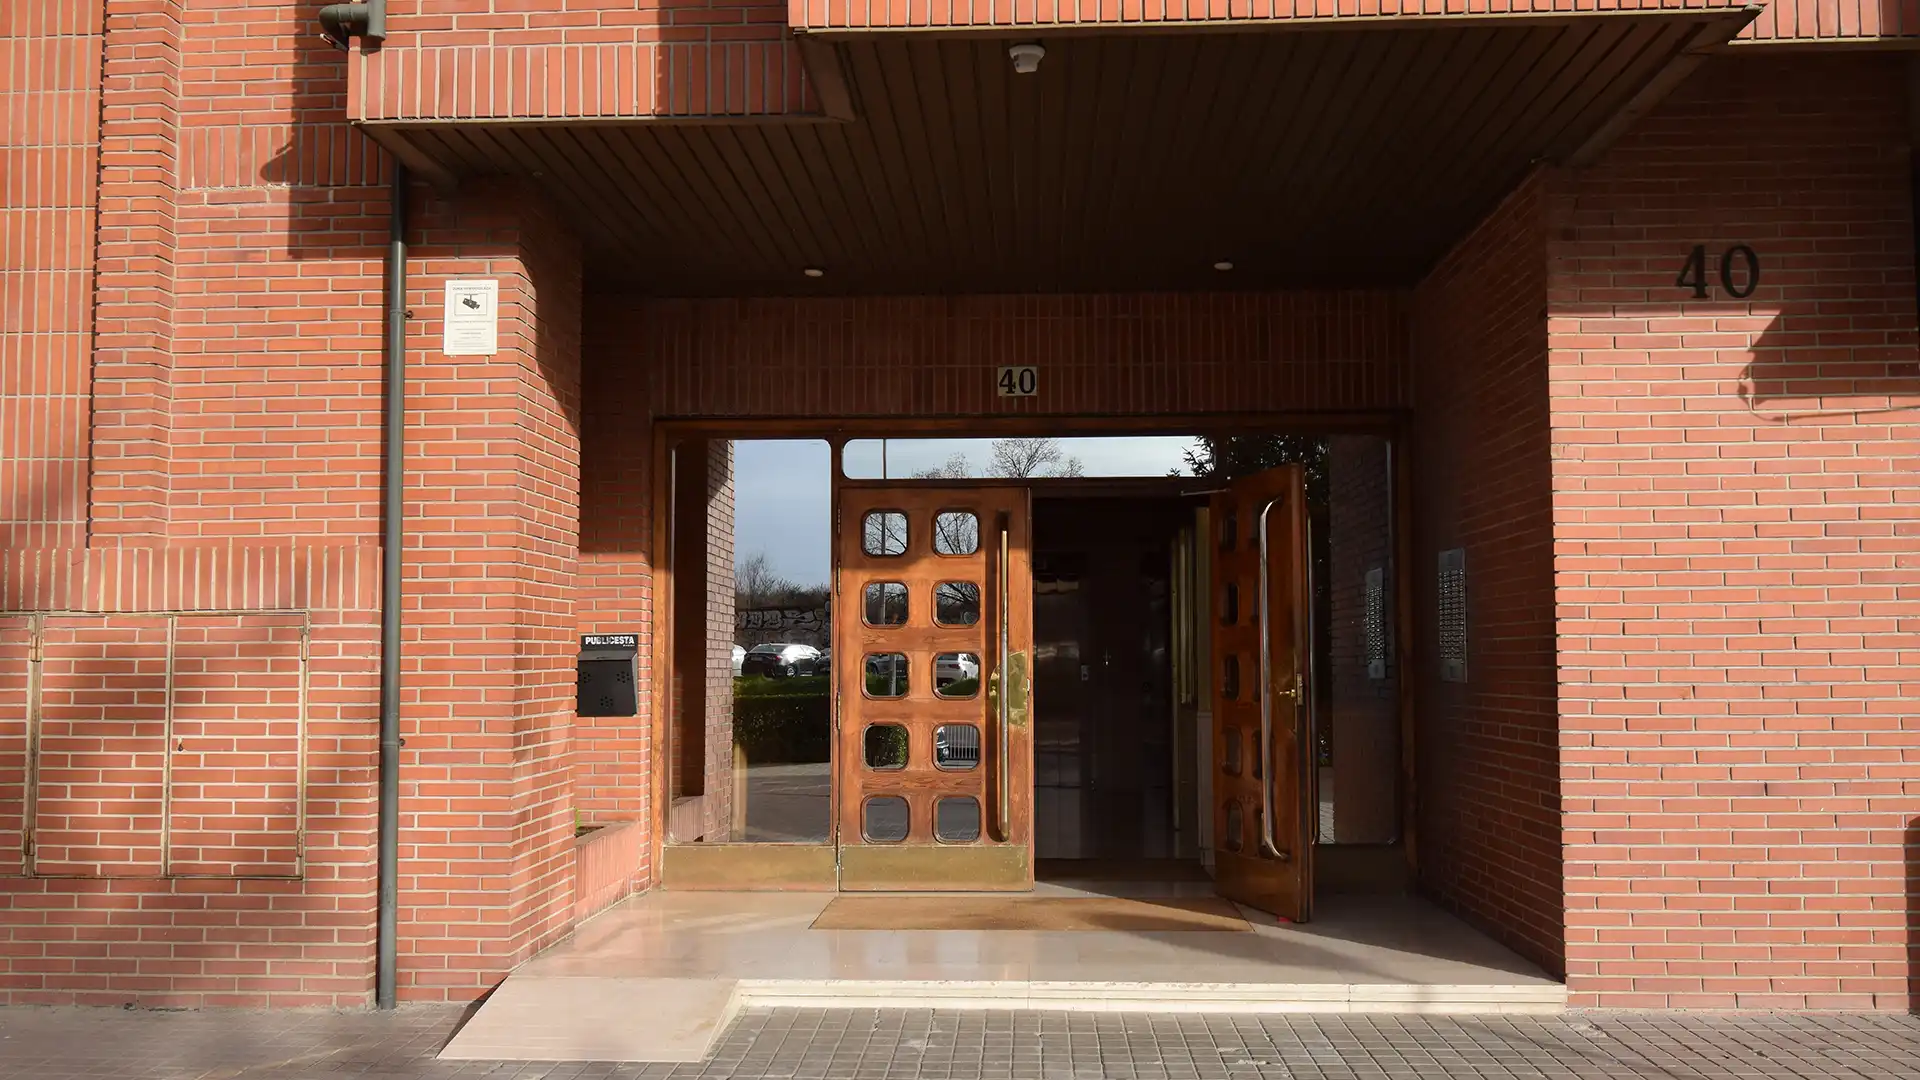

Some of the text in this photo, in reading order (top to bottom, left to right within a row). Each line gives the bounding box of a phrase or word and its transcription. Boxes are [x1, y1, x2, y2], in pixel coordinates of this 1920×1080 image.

[1676, 244, 1760, 298] 40
[999, 368, 1036, 394] 40
[585, 636, 635, 645] PUBLICESTA
